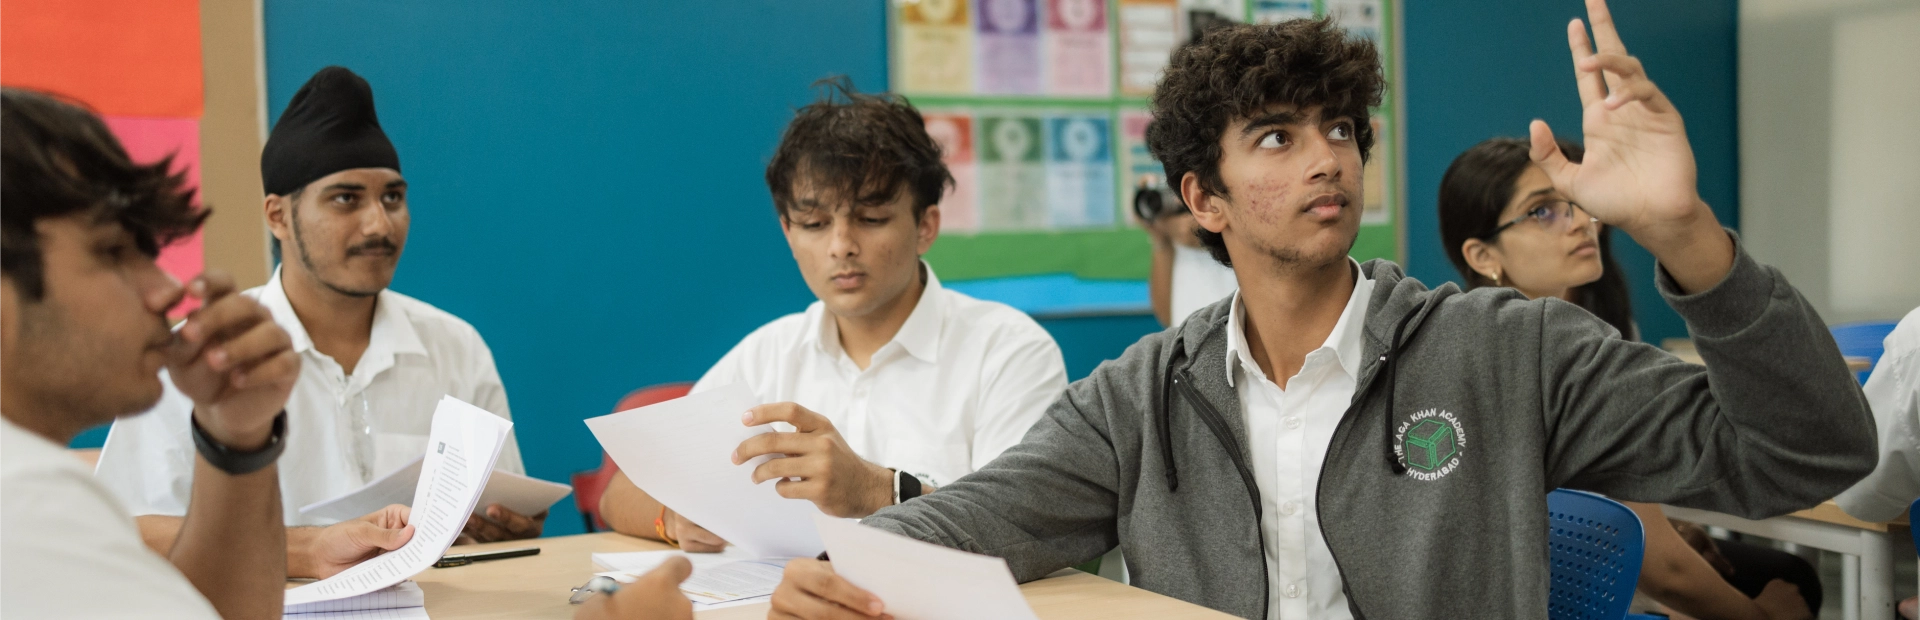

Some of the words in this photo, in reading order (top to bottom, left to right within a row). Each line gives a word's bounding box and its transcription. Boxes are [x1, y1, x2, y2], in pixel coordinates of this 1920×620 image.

[1396, 421, 1410, 443] AGA
[1410, 408, 1436, 422] KHAN
[1438, 409, 1466, 447] ACADEMY
[1406, 457, 1459, 481] HYDERABAD
